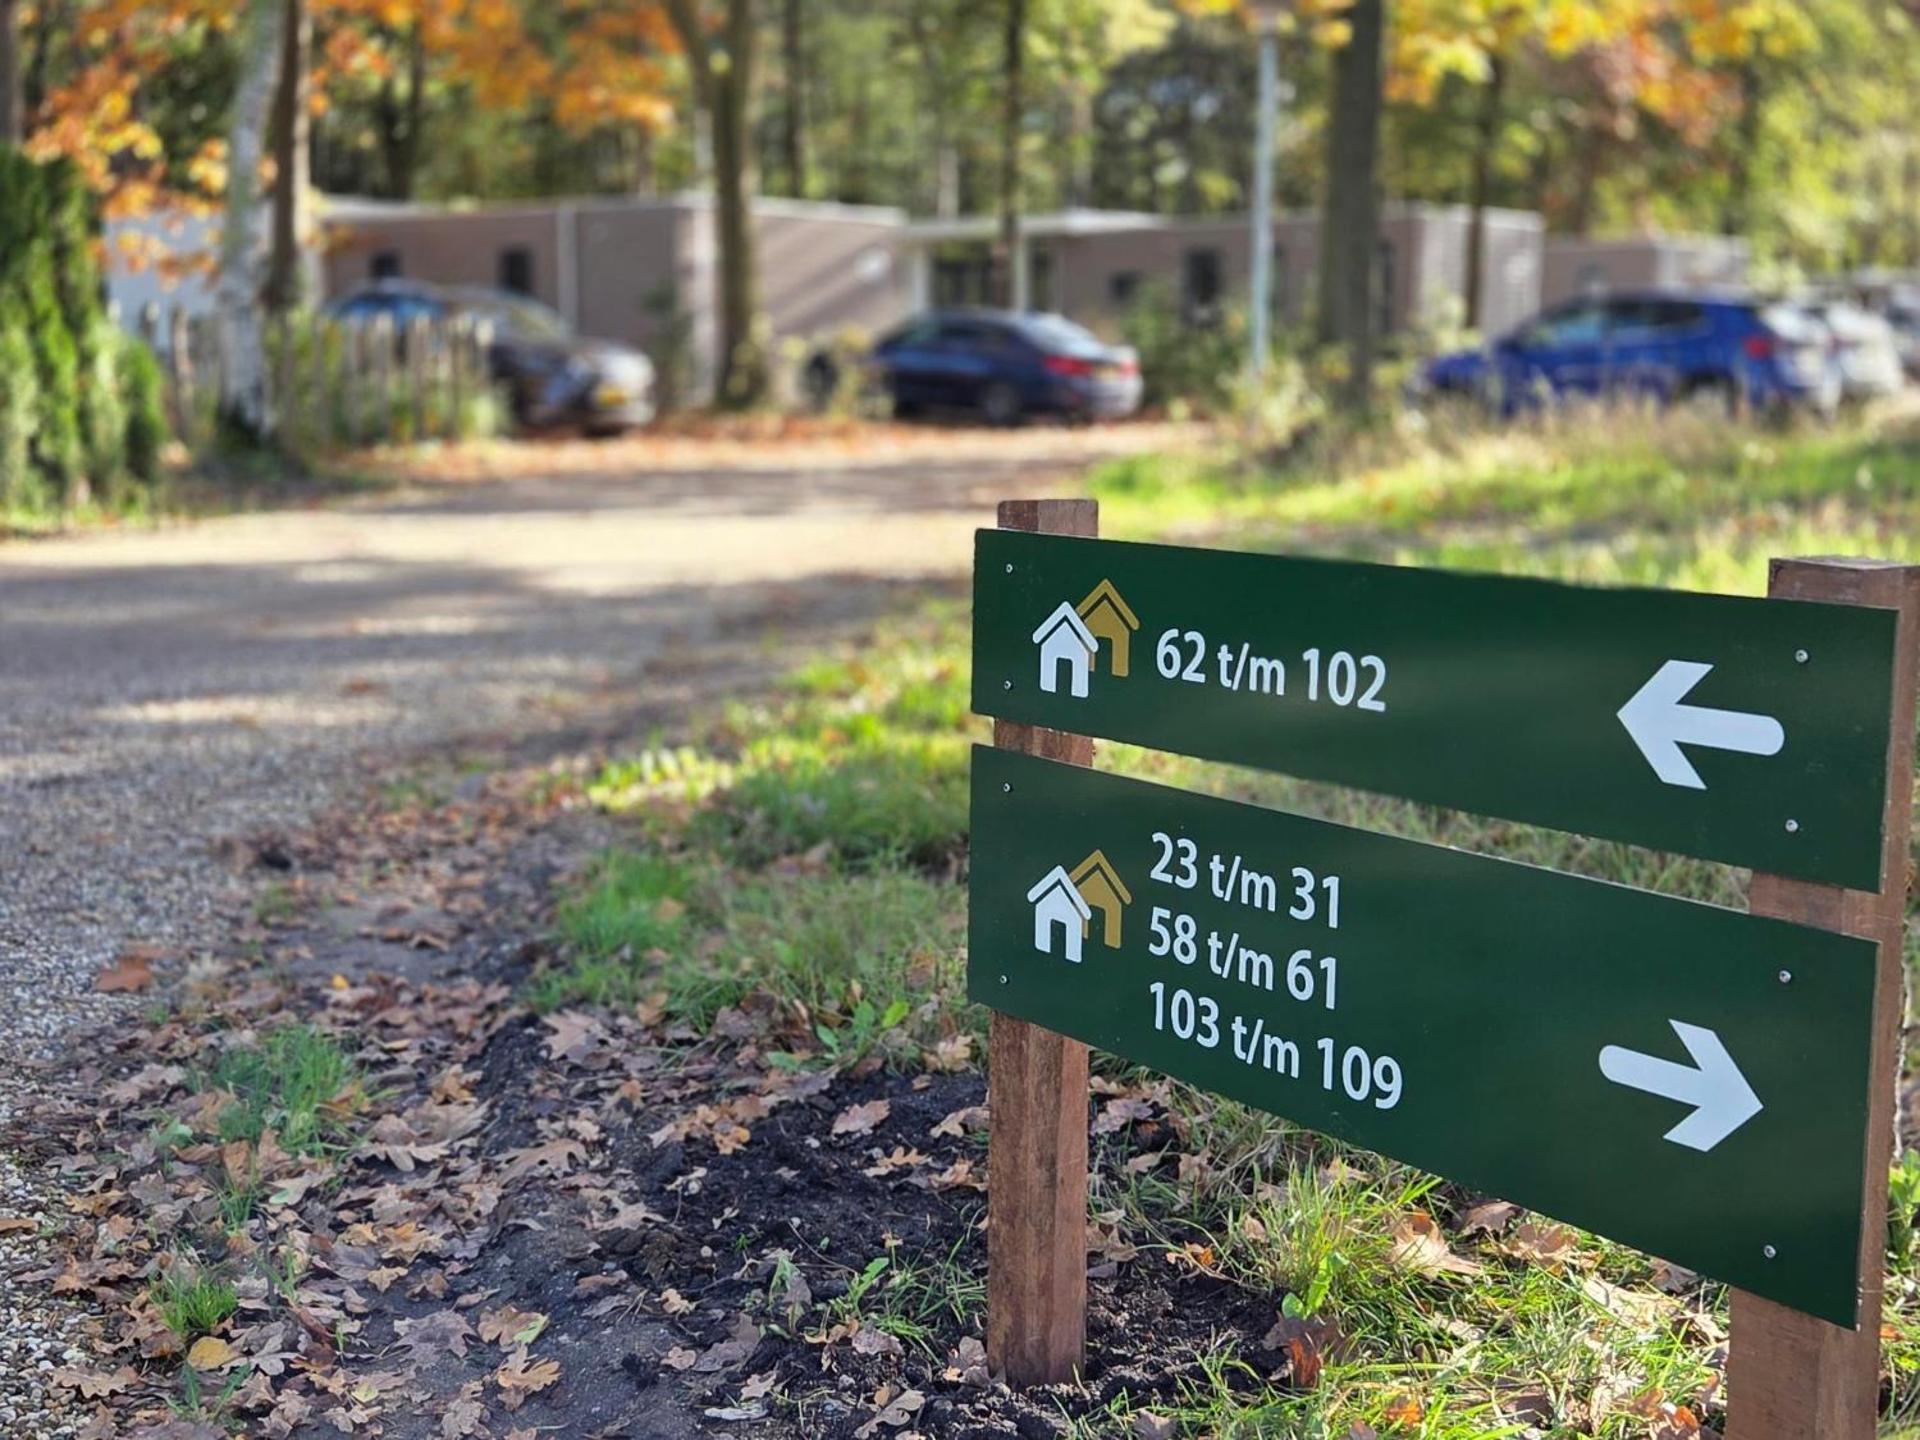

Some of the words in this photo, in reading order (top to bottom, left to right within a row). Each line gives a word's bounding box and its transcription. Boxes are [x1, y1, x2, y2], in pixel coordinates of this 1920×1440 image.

[1156, 628, 1206, 684] 62
[1217, 642, 1286, 697] t/m
[1302, 647, 1387, 713] 102
[1149, 831, 1198, 889] 23
[1209, 854, 1277, 913] t/m
[1289, 866, 1340, 929] 31
[1148, 906, 1198, 965] 58
[1207, 931, 1274, 991] t/m
[1286, 949, 1337, 1010] 61
[1149, 981, 1220, 1048] 103
[1230, 1015, 1300, 1079] t/m
[1317, 1037, 1403, 1110] 109
